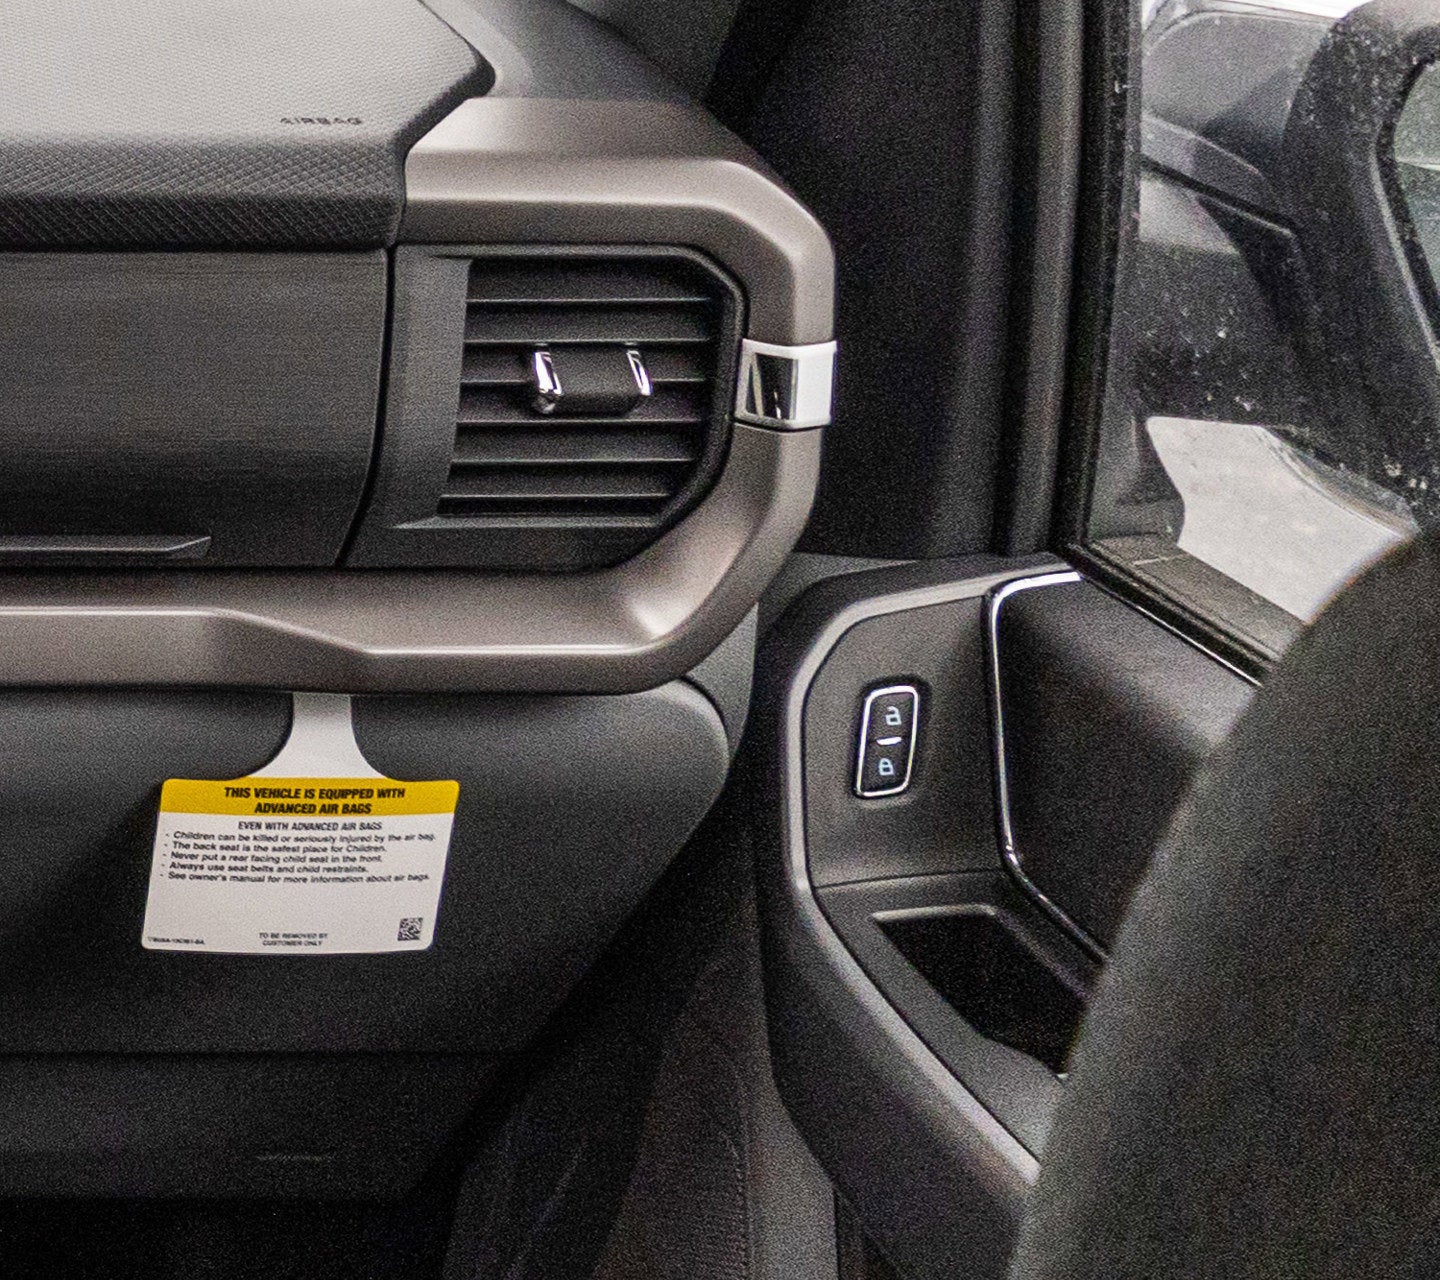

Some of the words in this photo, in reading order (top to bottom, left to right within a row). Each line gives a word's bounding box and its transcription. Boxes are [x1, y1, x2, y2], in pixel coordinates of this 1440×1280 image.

[225, 787, 251, 798] THIS
[254, 788, 301, 799] VEHICLE
[304, 788, 315, 799] IS
[319, 788, 374, 800] EQUIPPED
[377, 788, 405, 798] WITH
[255, 802, 316, 814] ADVANCED
[319, 804, 339, 814] AIR
[342, 803, 372, 814] BAGS
[238, 821, 262, 830] EVEN
[265, 822, 288, 830] WITH
[292, 822, 339, 830] ADVANCED
[341, 822, 357, 830] AIR
[359, 822, 382, 830] BAGS
